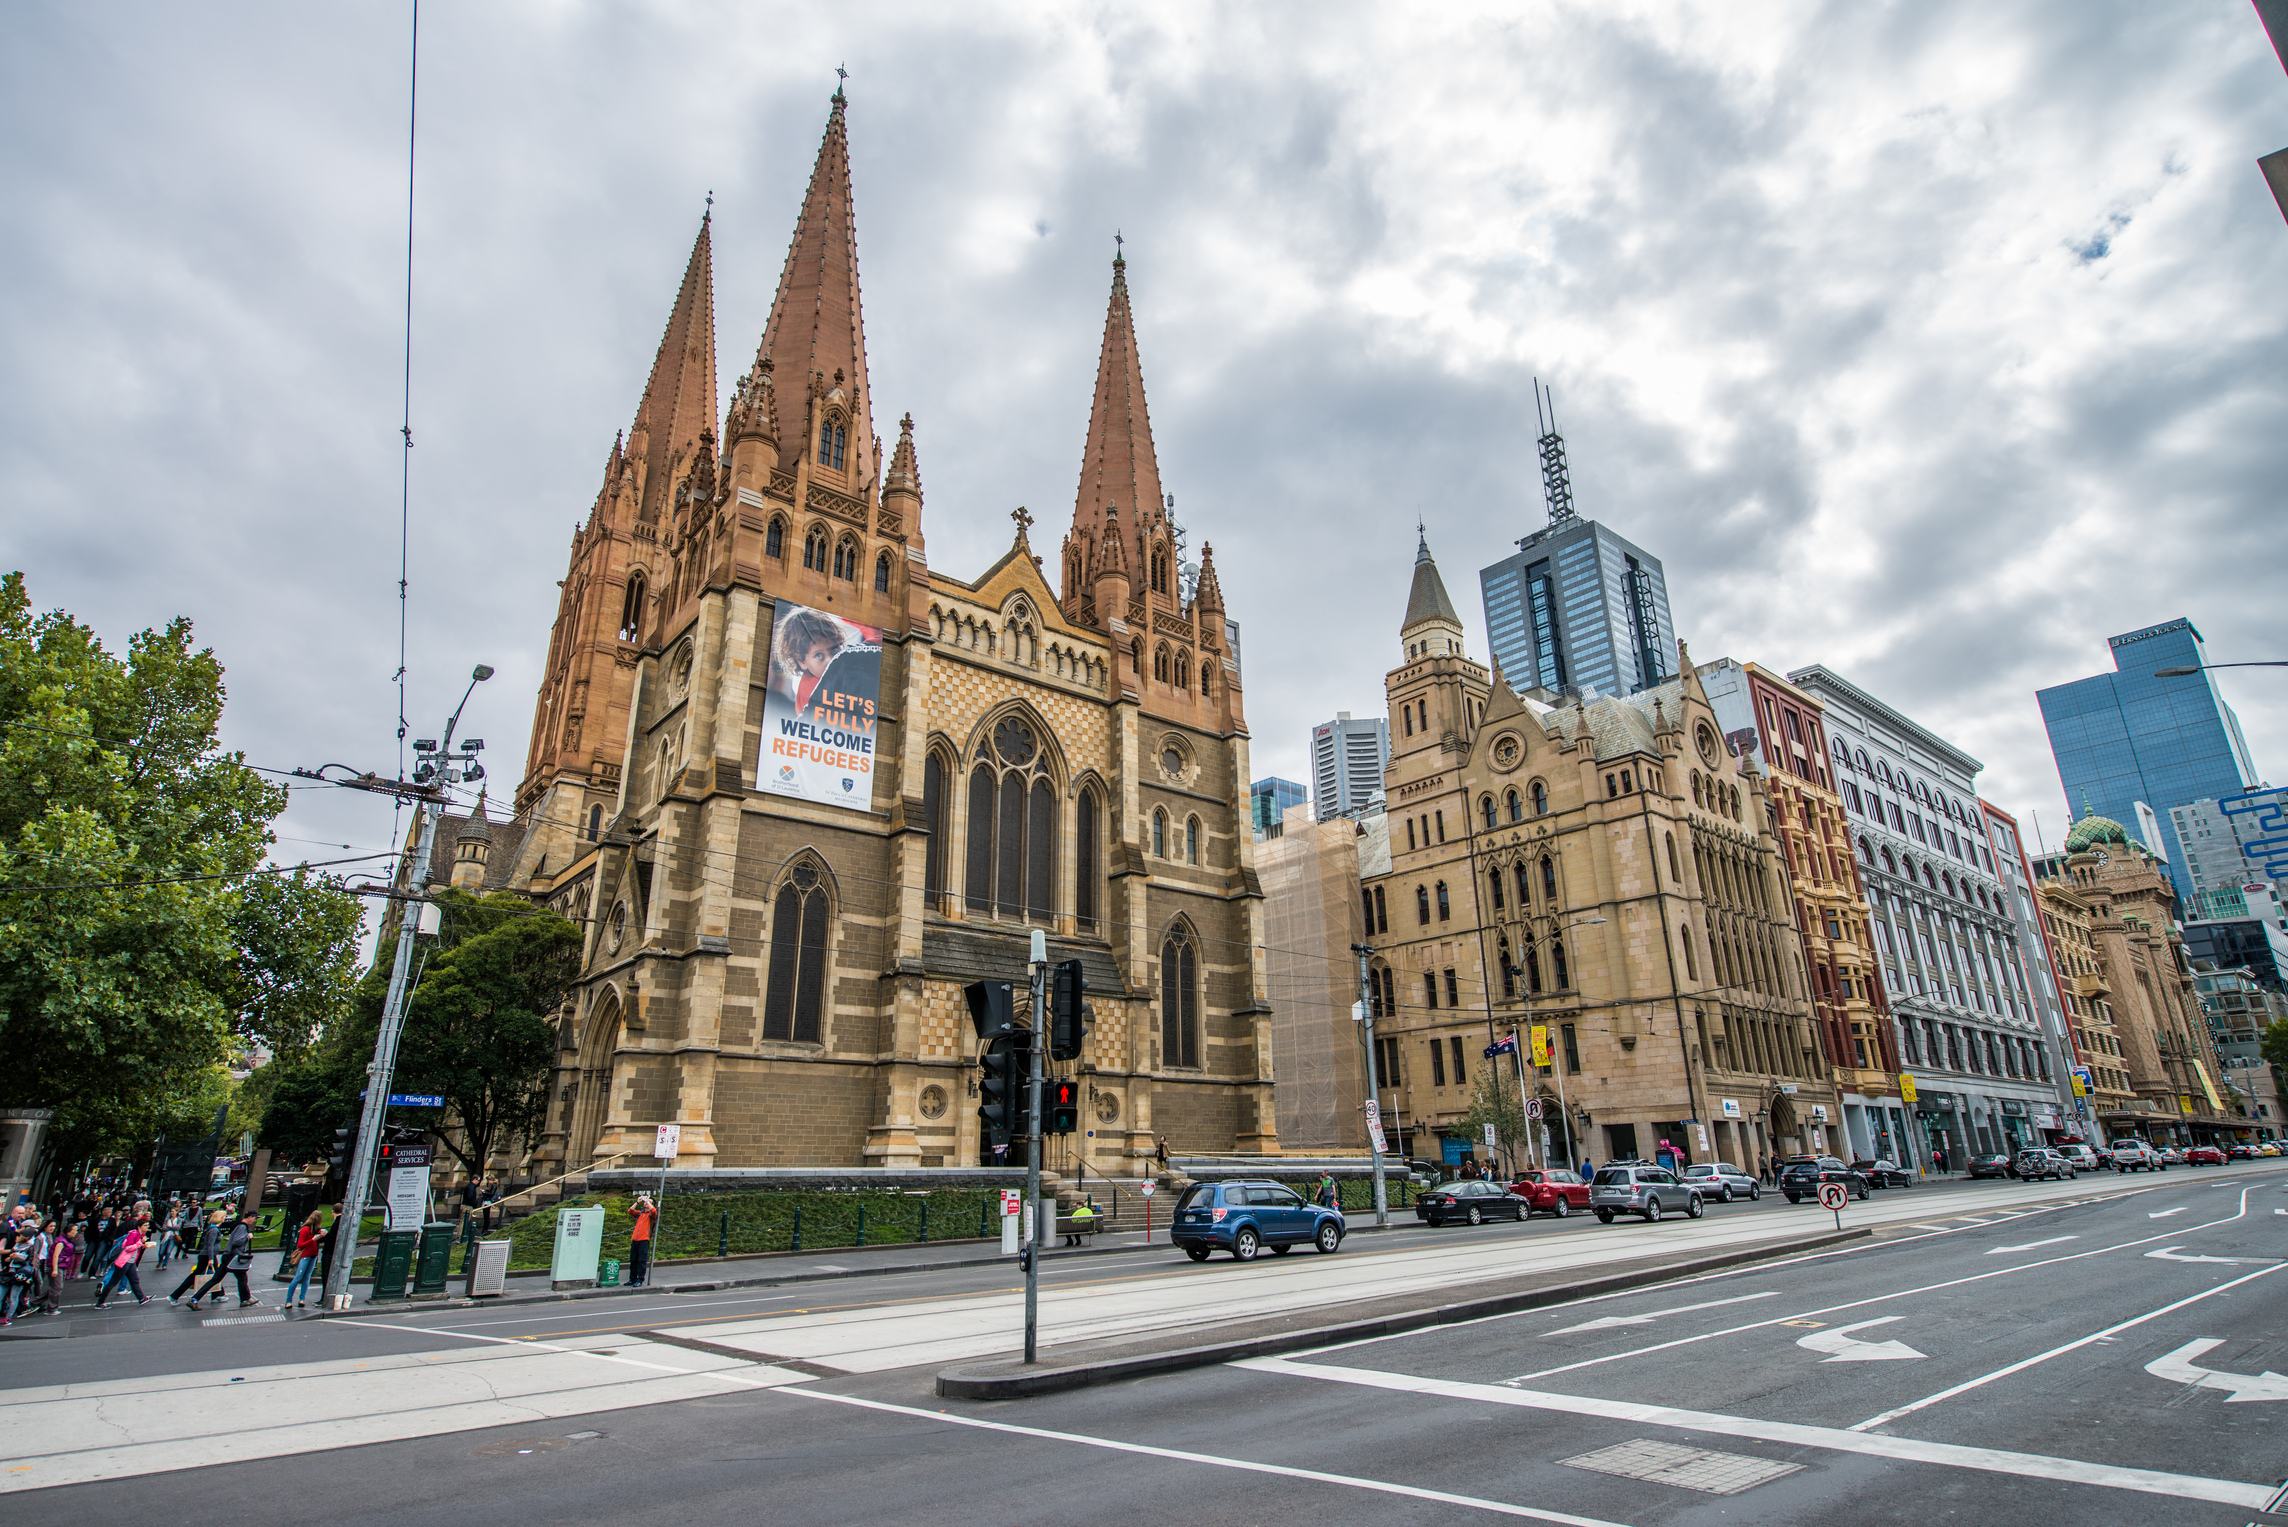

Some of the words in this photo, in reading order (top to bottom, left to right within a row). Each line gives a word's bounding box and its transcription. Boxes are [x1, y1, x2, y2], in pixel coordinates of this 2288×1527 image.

[822, 689, 875, 716] LET'S
[814, 706, 874, 735] FULLY
[781, 718, 872, 754] WELCOME
[772, 737, 870, 774] REFUGEES
[404, 1095, 432, 1103] Flinders
[434, 1096, 442, 1104] St
[395, 1149, 427, 1157] CATHEDRAL
[398, 1156, 425, 1164] SERVICES
